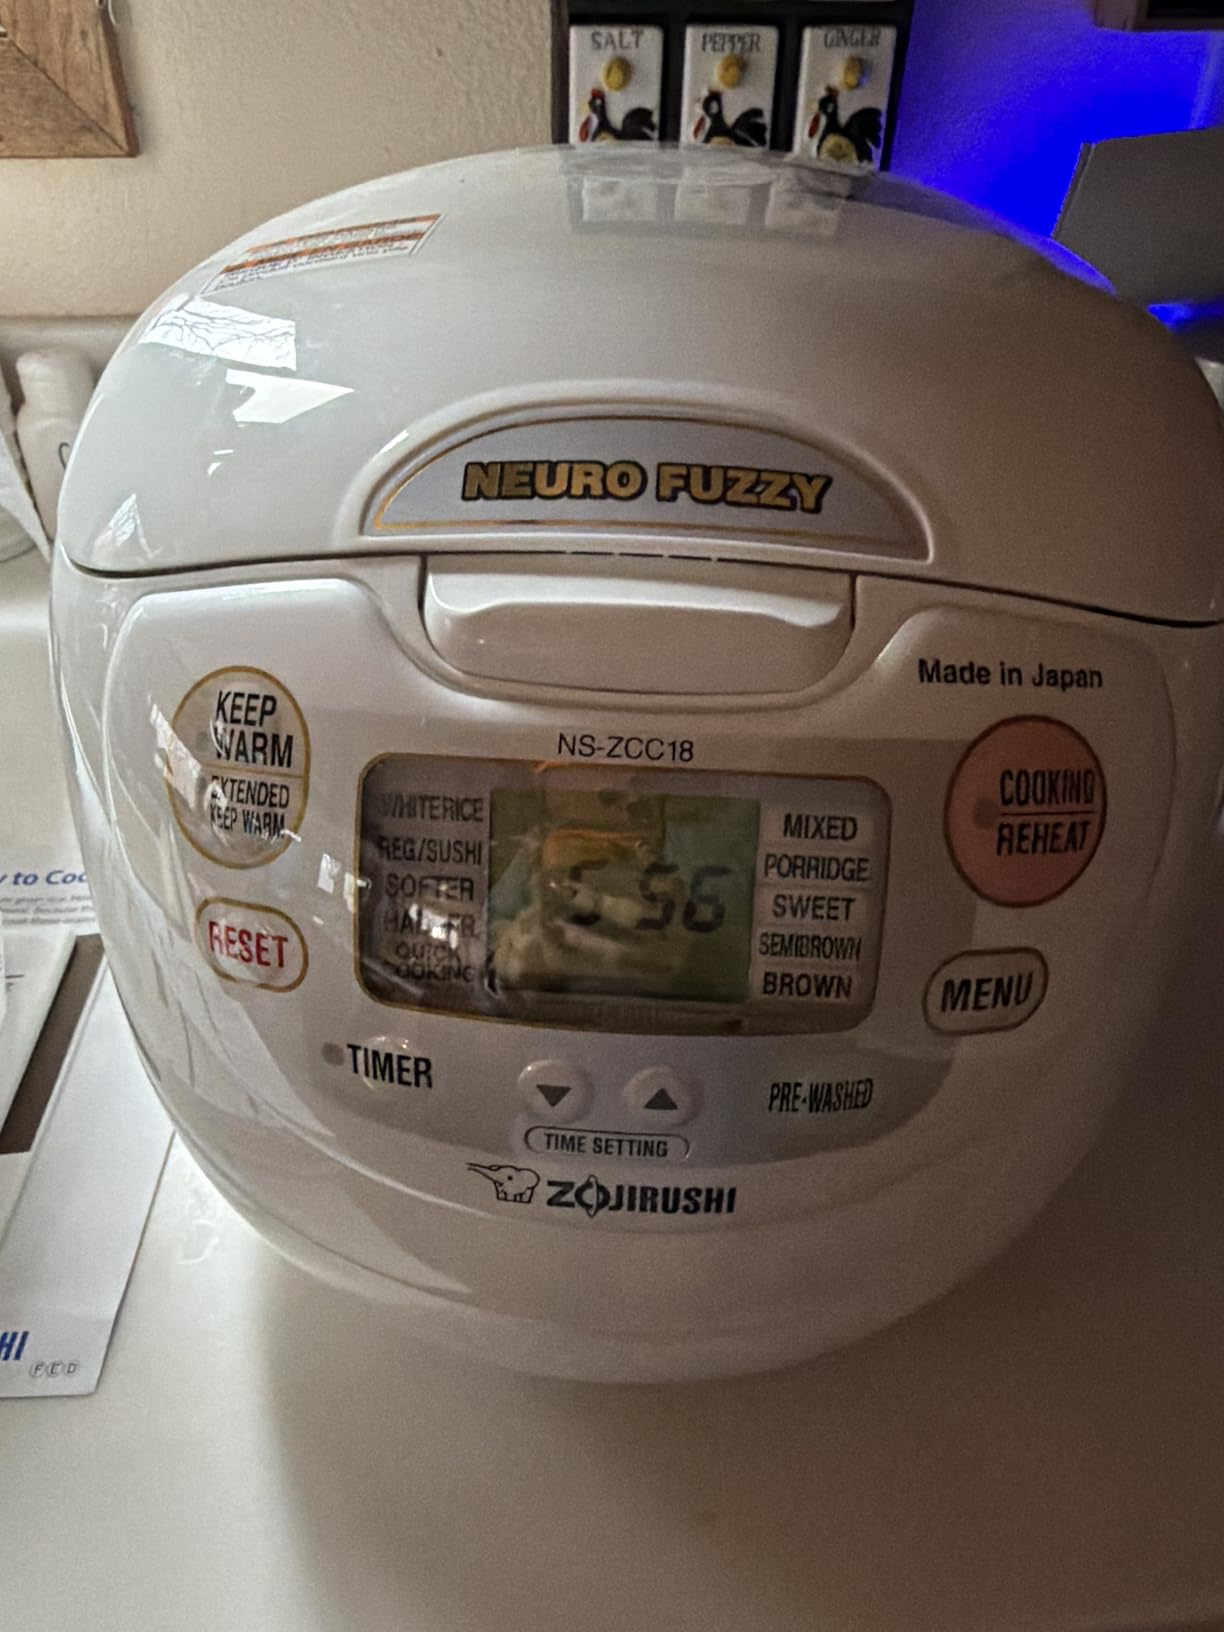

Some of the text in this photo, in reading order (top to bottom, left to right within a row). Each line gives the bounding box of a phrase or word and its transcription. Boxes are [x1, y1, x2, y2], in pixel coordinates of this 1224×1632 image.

[591, 30, 643, 49] SALT
[702, 33, 761, 51] PEPPER
[823, 28, 881, 49] GINGER
[462, 461, 833, 514] NEURO FUZZY
[918, 659, 1103, 690] Made in Japan
[215, 690, 277, 726] KEEP
[213, 725, 294, 769] WARM
[557, 733, 694, 762] NS-ZCC18
[211, 775, 290, 809] EXTENDED
[1000, 769, 1096, 806] COOKING
[209, 802, 286, 840] KEEP WARM
[783, 813, 858, 841] MIXED
[379, 834, 482, 866] REG/SUSHI
[996, 820, 1091, 856] REHEAT
[12, 871, 38, 886] to
[764, 853, 870, 882] PORRIDGE
[385, 874, 475, 901] SOFTER
[772, 894, 856, 921] SWEET
[208, 920, 288, 968] RESET
[759, 932, 861, 961] SEMIBROWN
[762, 971, 851, 999] BROWN
[940, 972, 1033, 1013] MENU
[346, 1043, 432, 1089] TIMER
[768, 1078, 874, 1113] PRE-WASHED
[544, 1132, 668, 1158] TIME SETTING
[546, 1174, 737, 1218] ZOJIRUSHI
